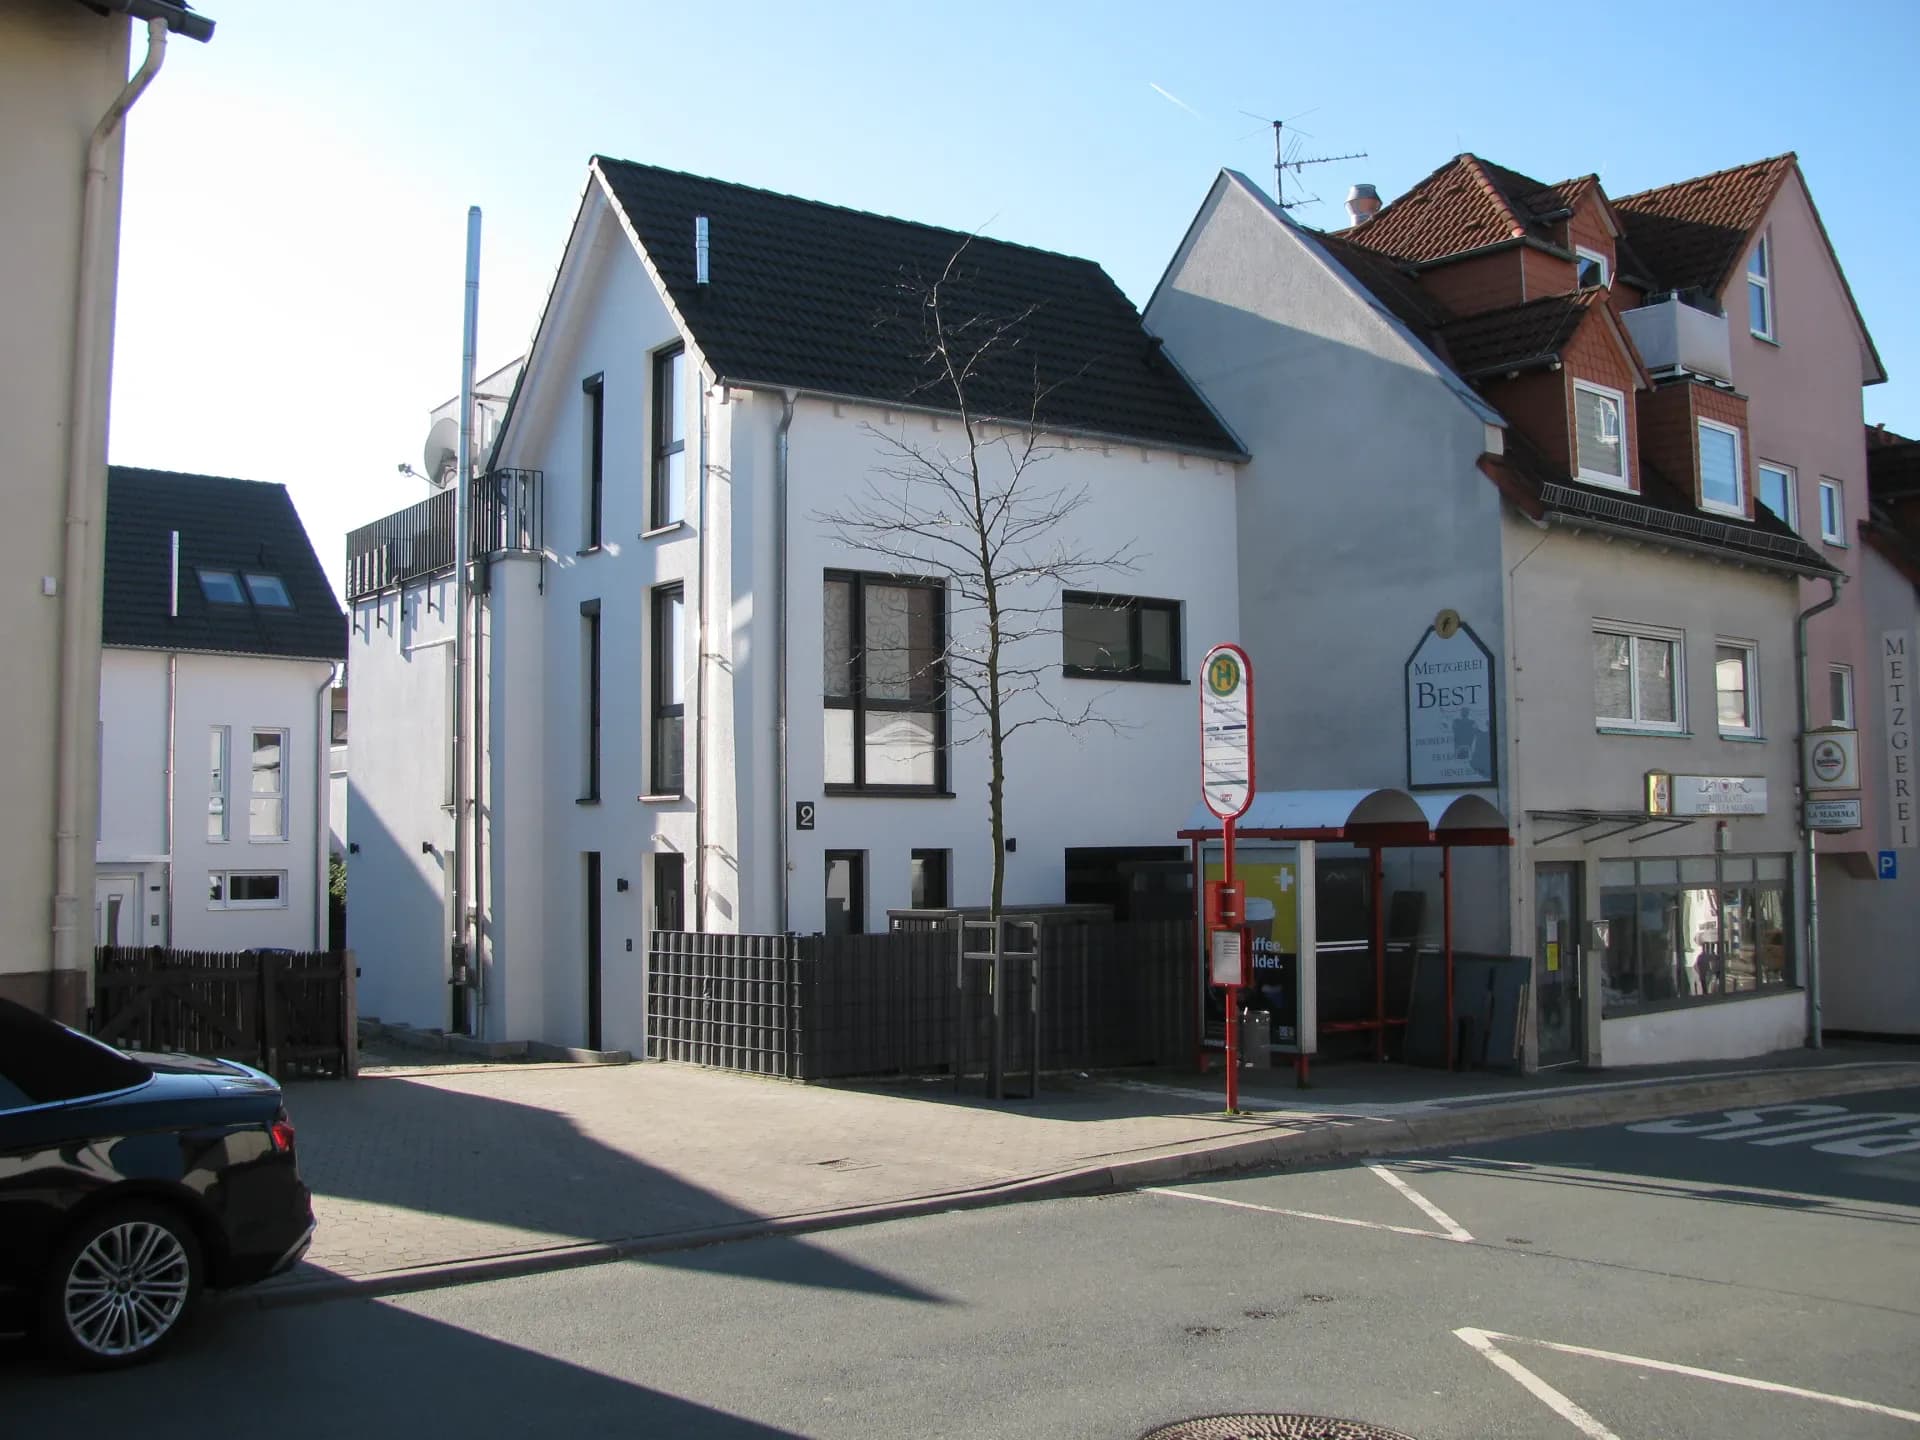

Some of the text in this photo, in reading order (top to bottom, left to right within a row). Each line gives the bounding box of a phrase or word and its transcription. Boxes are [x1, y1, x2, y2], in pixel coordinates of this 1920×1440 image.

[1216, 663, 1231, 687] H
[1414, 659, 1483, 676] METZGEREI
[1416, 682, 1482, 709] BEST
[1885, 638, 1910, 845] METZGEREI
[800, 805, 813, 826] 2
[1819, 810, 1856, 818] MAMMA
[1881, 856, 1893, 874] P
